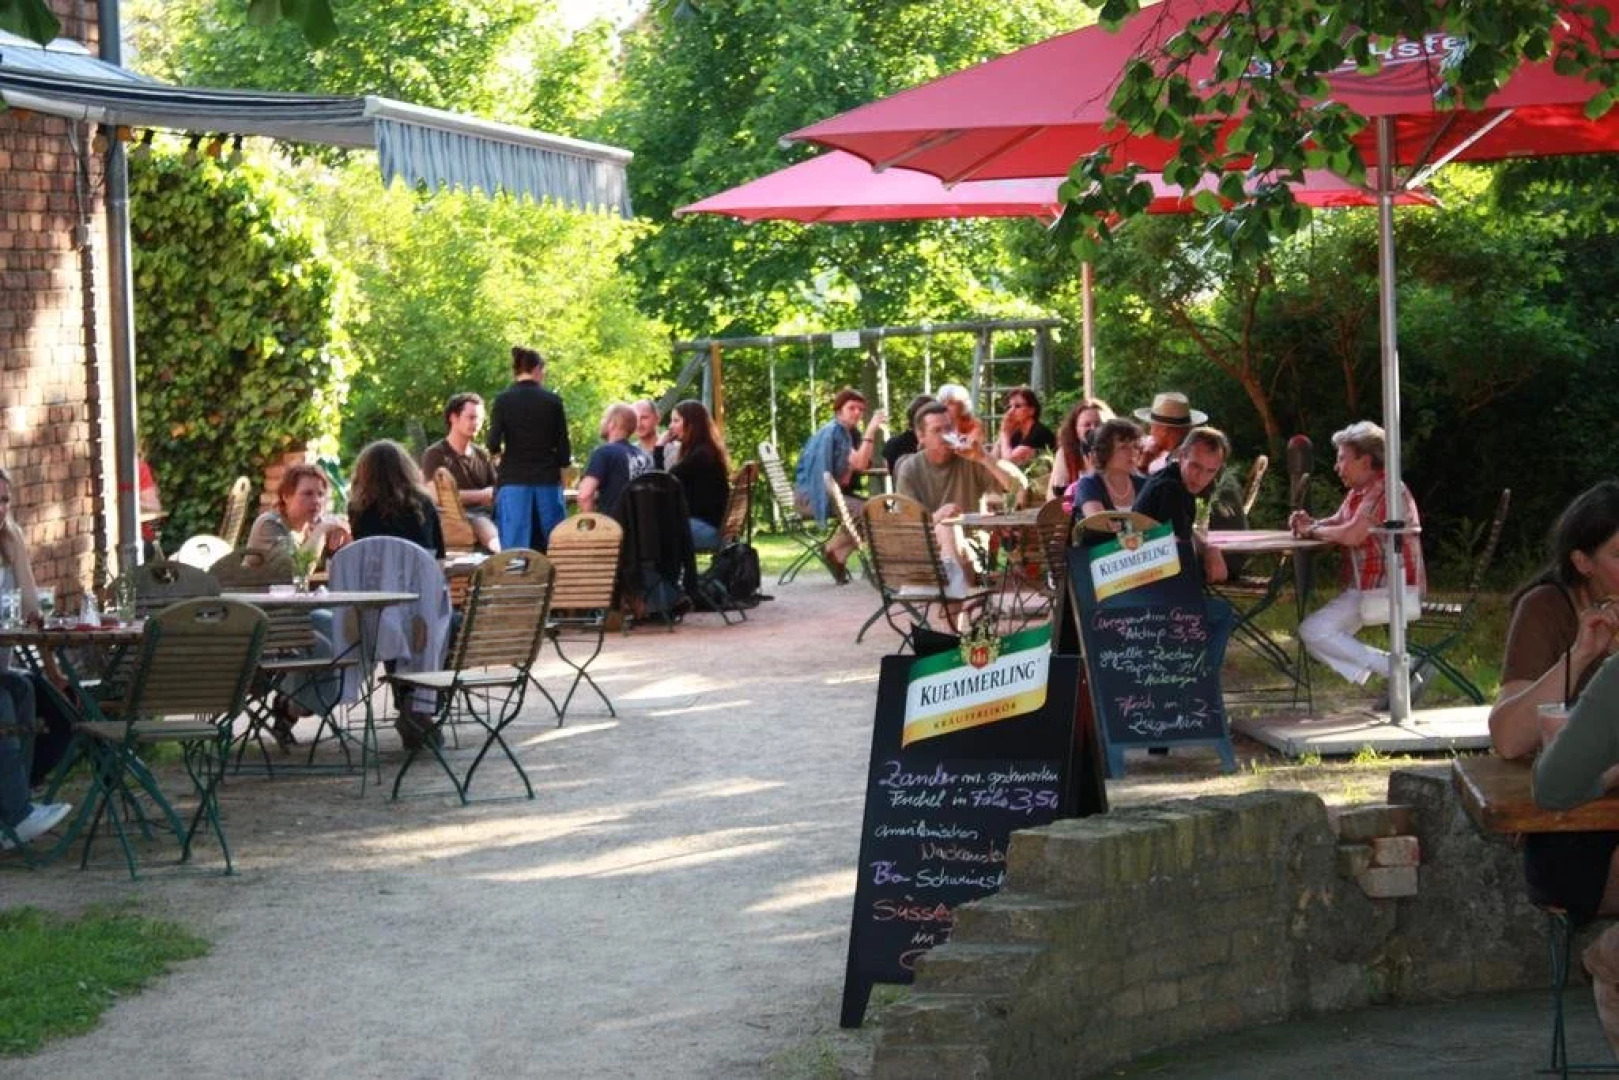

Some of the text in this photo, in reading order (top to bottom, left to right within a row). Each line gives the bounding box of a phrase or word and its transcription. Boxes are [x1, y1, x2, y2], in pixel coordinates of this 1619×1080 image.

[1100, 544, 1173, 577] KUEMMERLING
[920, 660, 1035, 706] KUEMMERLING
[879, 760, 957, 788] Zander
[952, 788, 967, 806] in
[1008, 788, 1059, 815] 3,50
